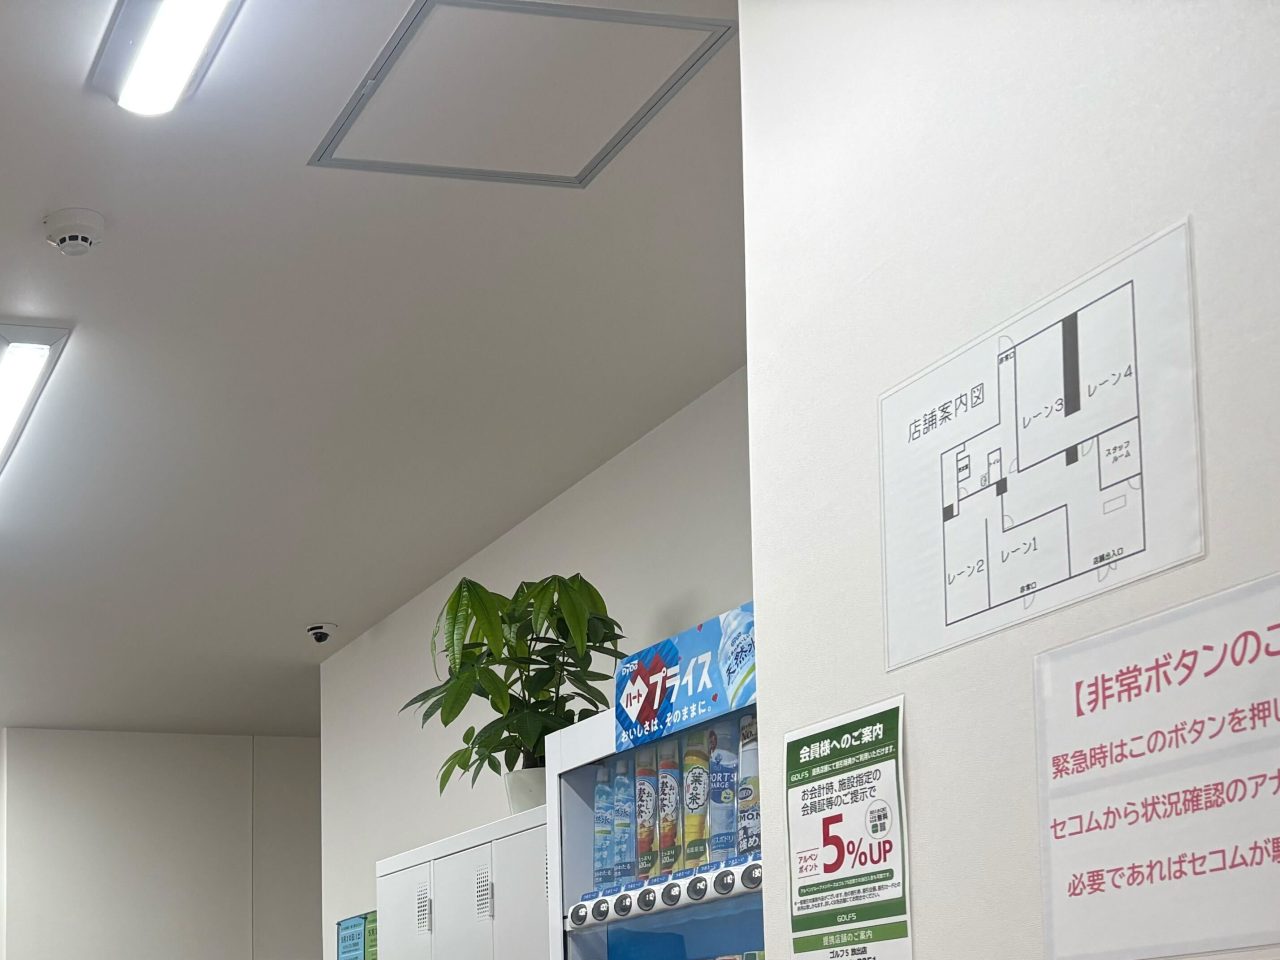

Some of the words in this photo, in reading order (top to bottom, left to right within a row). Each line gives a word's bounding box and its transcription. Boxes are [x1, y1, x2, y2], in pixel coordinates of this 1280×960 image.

[1087, 365, 1133, 397] レーン4
[908, 383, 984, 443] 店舗案内図
[1022, 398, 1064, 429] レーン3
[1105, 441, 1130, 456] スタッフ
[1001, 537, 1038, 563] レーン1
[947, 559, 985, 586] レーン2
[649, 651, 713, 710] プライス
[626, 689, 642, 708] ハート
[621, 701, 711, 741] おいしさは、そのままに。
[800, 722, 884, 763] 会員様へのご案内
[801, 768, 881, 801] お会計時、施設指定の
[801, 786, 877, 817] 会員証等のご提示で
[798, 853, 818, 865] アルペン
[798, 863, 819, 874] ポイント
